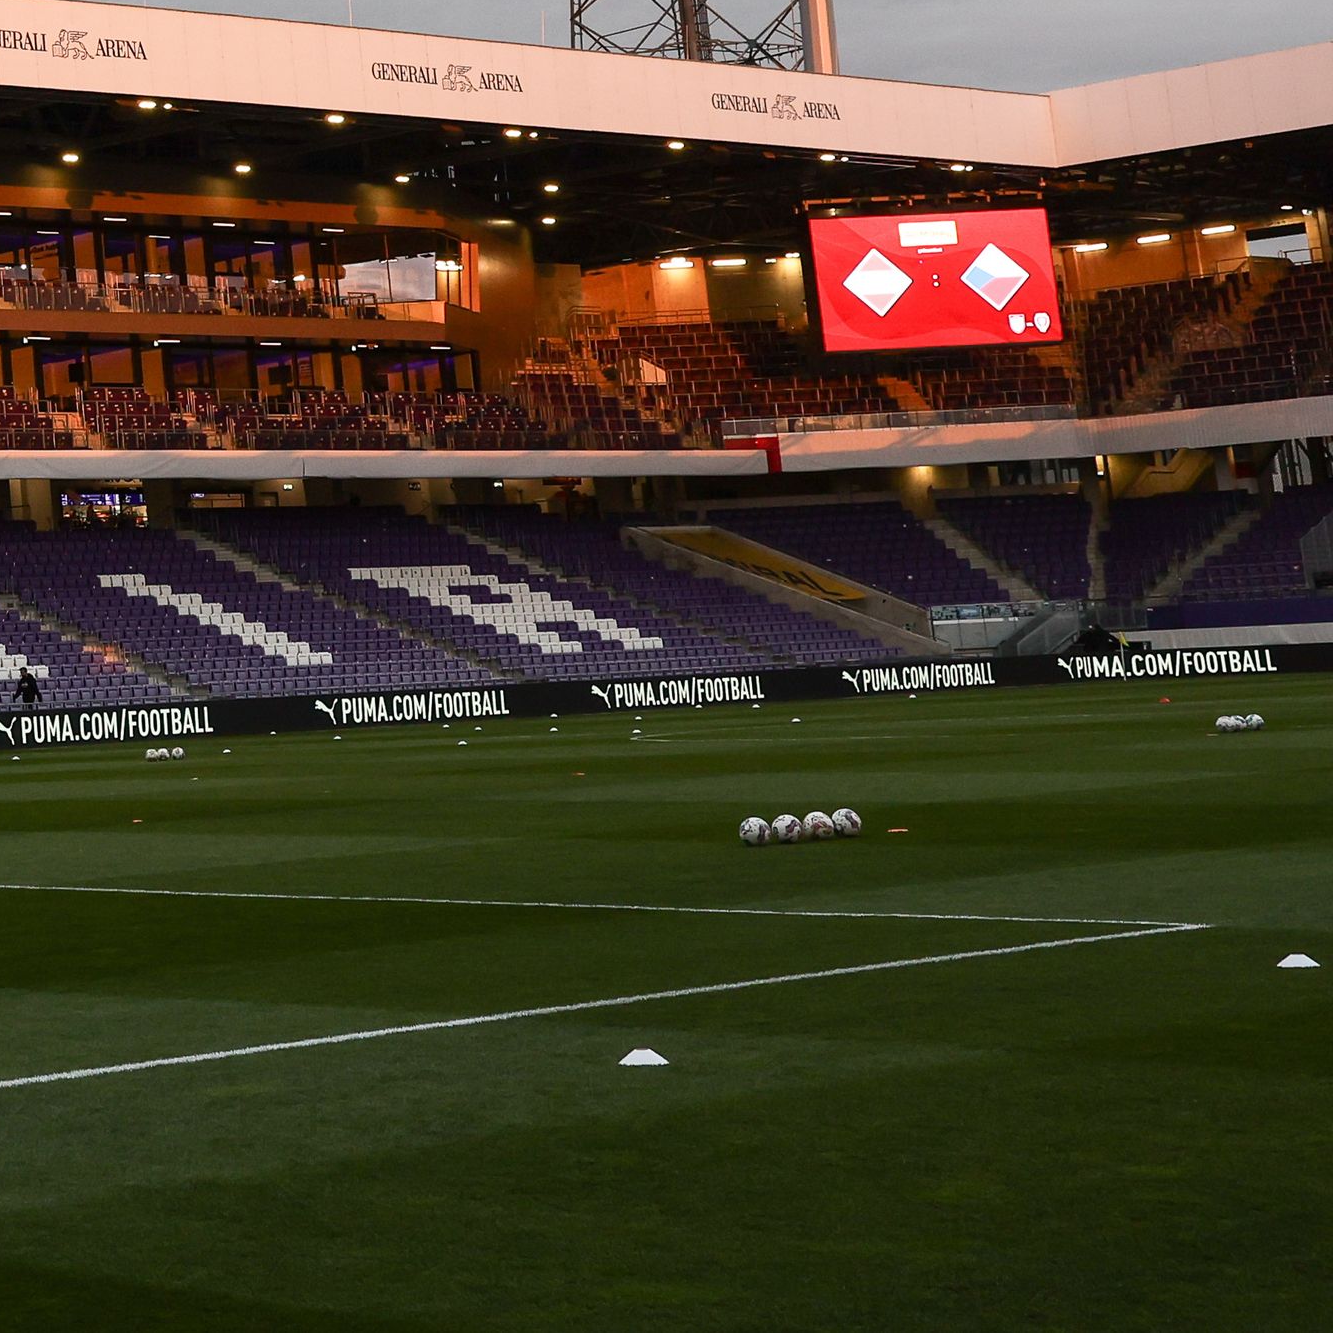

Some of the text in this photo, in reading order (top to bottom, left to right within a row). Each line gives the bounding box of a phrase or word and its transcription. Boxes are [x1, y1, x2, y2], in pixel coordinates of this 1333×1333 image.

[95, 38, 148, 61] ARENA
[371, 62, 524, 93] GENERALI ARENA
[711, 92, 841, 121] GENERALI ARENA
[862, 662, 996, 693] PUMA.COM/FOOTBALL
[1075, 649, 1278, 679] PUMA.COM/FOOTBALL
[341, 689, 510, 724] PUMA.COM/FOOTBALL
[614, 675, 765, 709] PUMA.COM/FOOTBALL
[20, 706, 214, 744] PUMA.COM/FOOTBALL
